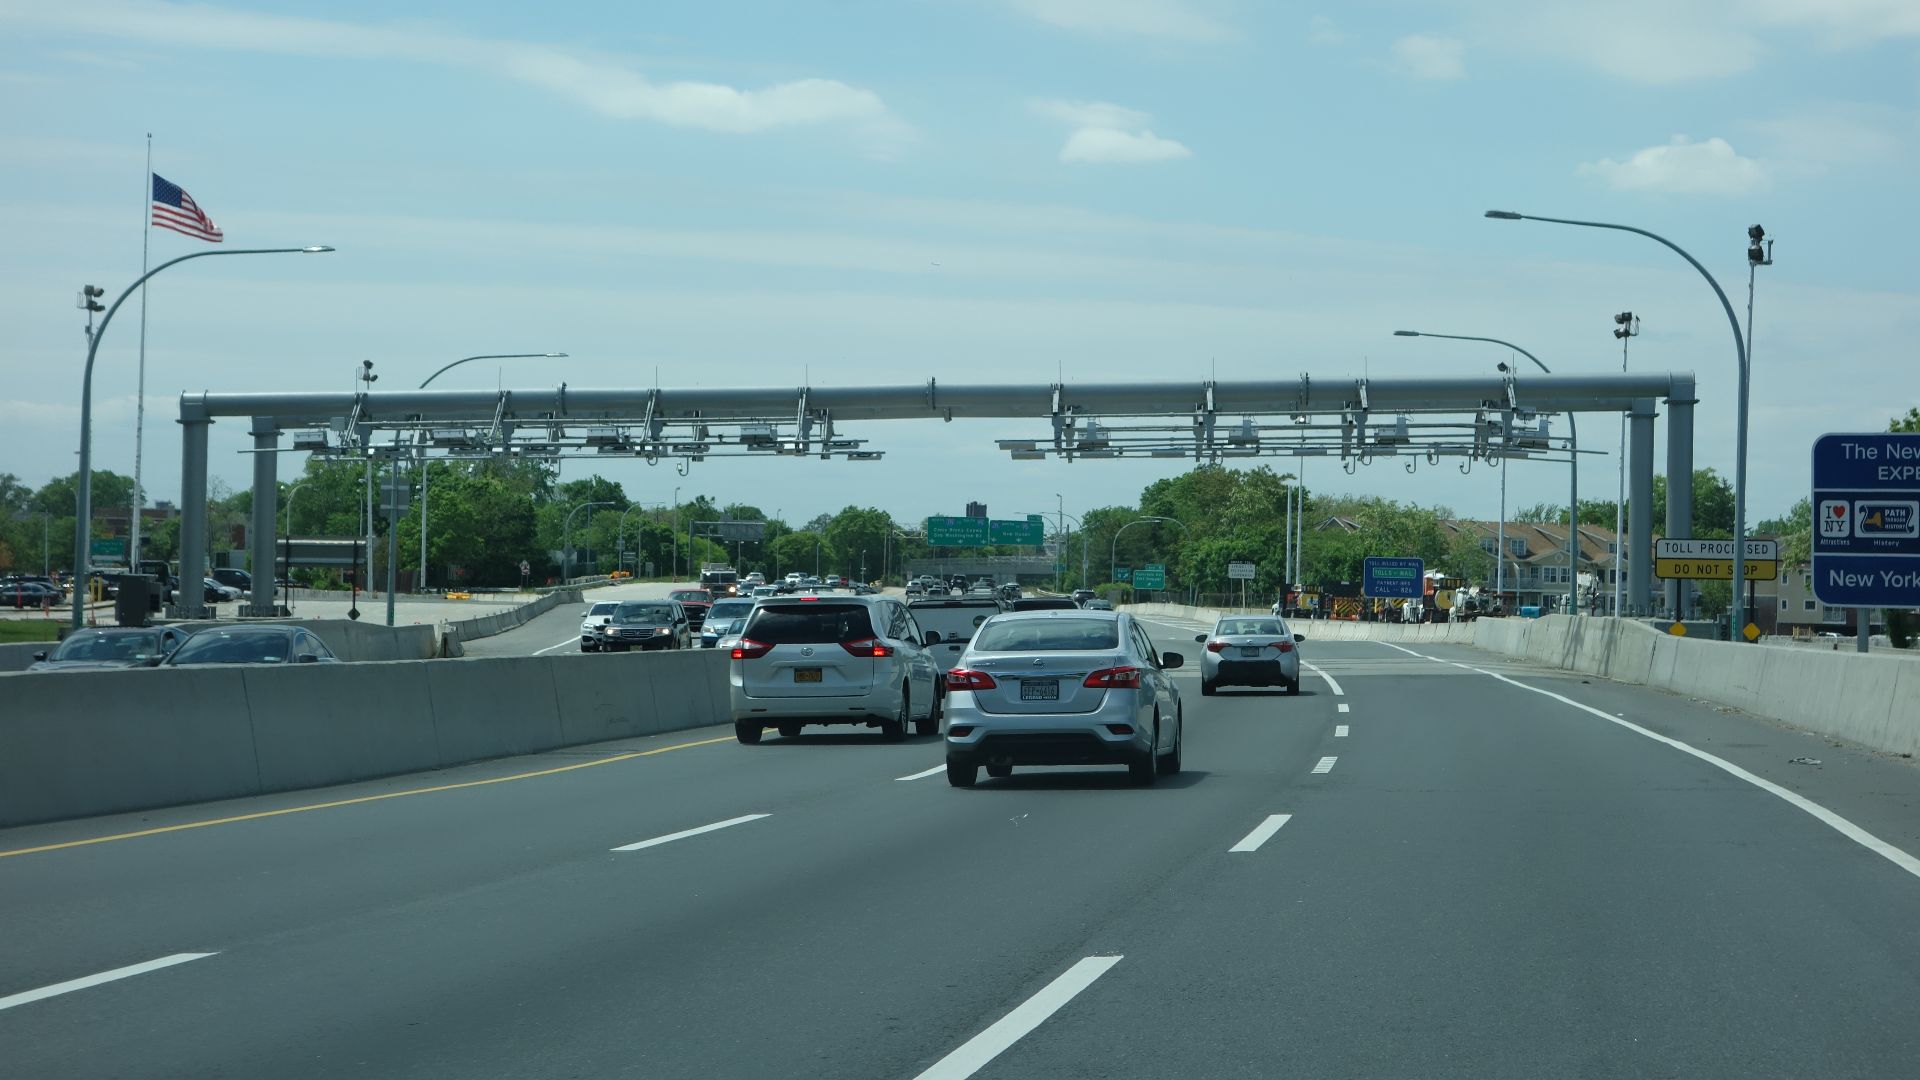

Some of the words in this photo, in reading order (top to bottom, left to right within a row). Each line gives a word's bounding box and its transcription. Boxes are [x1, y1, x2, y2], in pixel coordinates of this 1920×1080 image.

[1841, 443, 1878, 460] The
[1825, 505, 1832, 519] I
[1884, 509, 1906, 517] PATH
[1824, 520, 1846, 532] NY
[1820, 538, 1850, 546] Attractions
[1873, 539, 1900, 548] History
[1665, 542, 1693, 553] TOLL
[1700, 543, 1769, 555] PROCSED
[1674, 564, 1690, 575] DO
[1697, 564, 1720, 575] NOT
[1727, 565, 1758, 576] SOP
[1829, 569, 1875, 587] New
[1880, 570, 1920, 588] York
